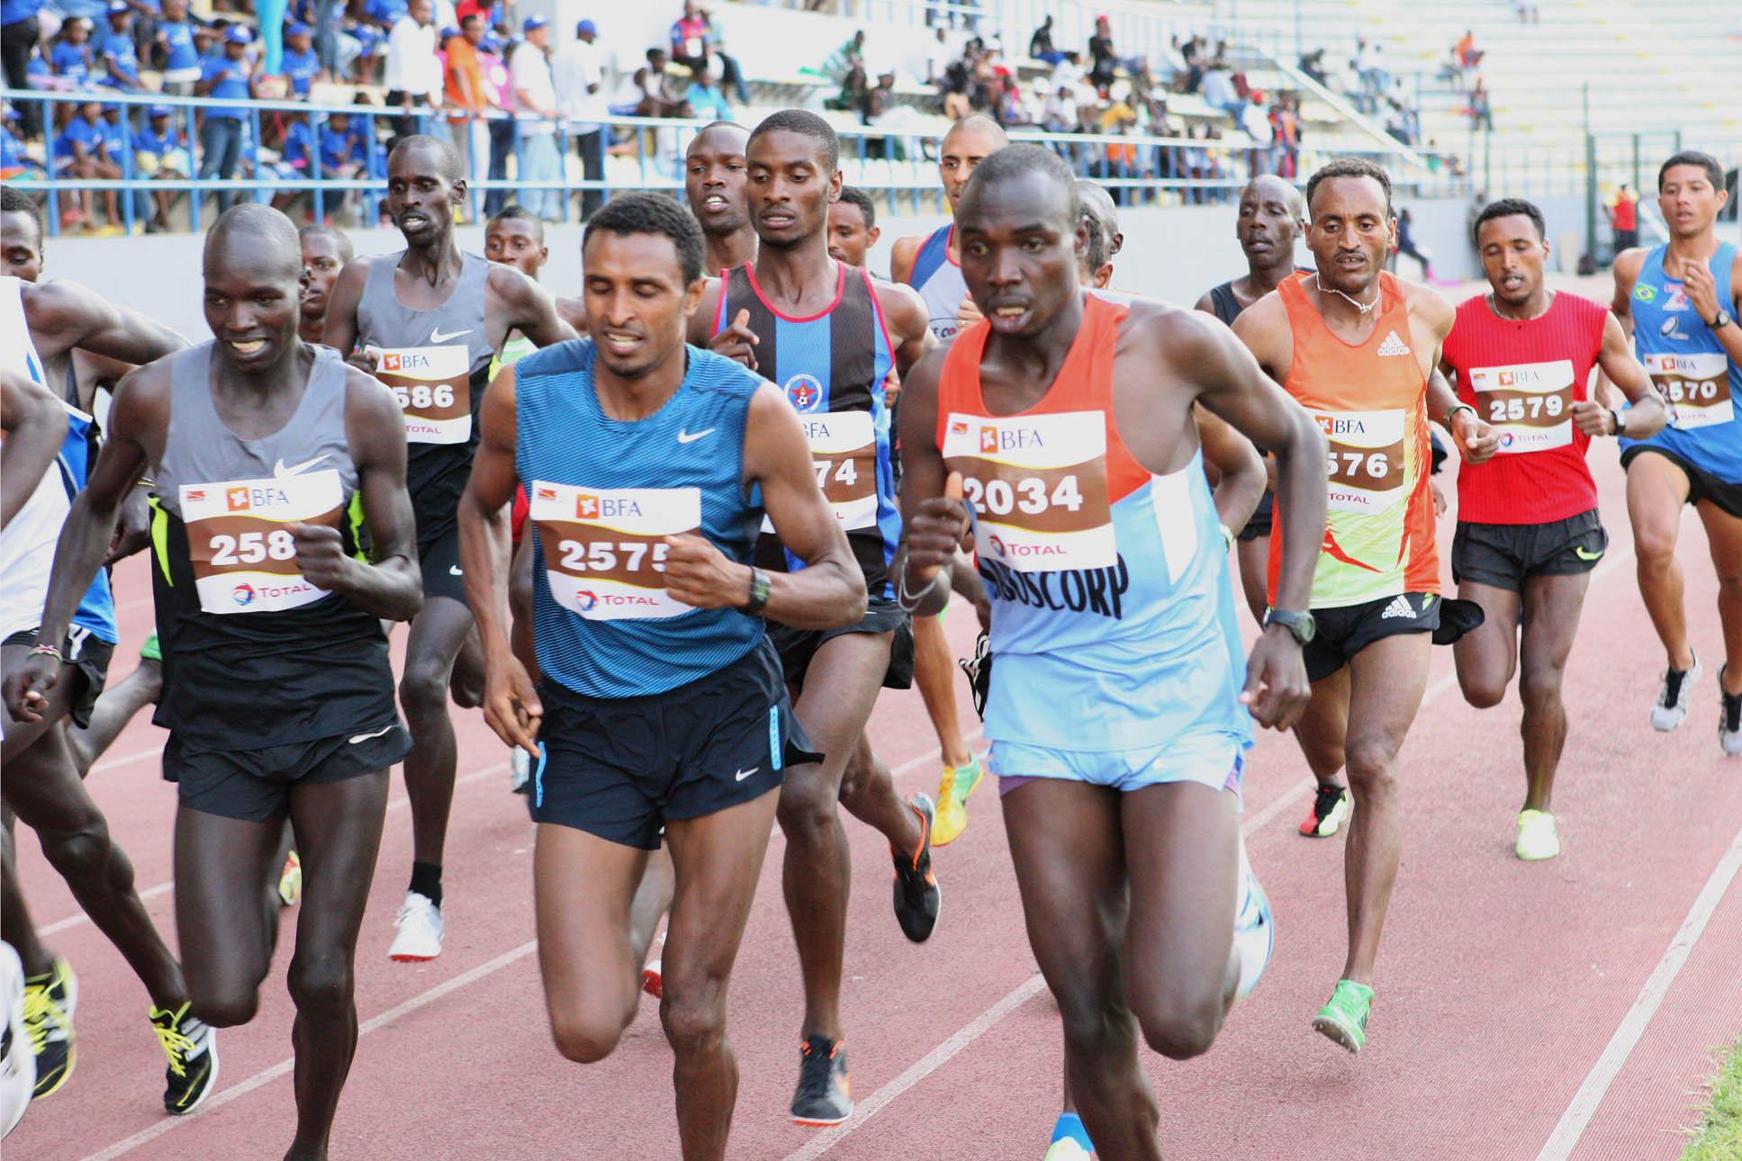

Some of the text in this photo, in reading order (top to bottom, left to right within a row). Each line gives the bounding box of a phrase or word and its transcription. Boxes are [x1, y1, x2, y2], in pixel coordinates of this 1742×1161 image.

[402, 355, 430, 369] BFA
[1490, 395, 1563, 421] 2579
[405, 425, 443, 434] TOTAL
[1335, 419, 1366, 434] BFA
[1001, 429, 1044, 450] BFA
[252, 487, 290, 507] BFA
[963, 475, 1084, 516] 2034
[1329, 493, 1371, 505] TOTAL
[602, 498, 643, 517] BFA
[209, 529, 297, 566] 258
[1007, 543, 1068, 557] TOTAL
[258, 585, 312, 598] TOTAL
[602, 594, 660, 606] TOTAL
[1381, 607, 1417, 619] adidas
